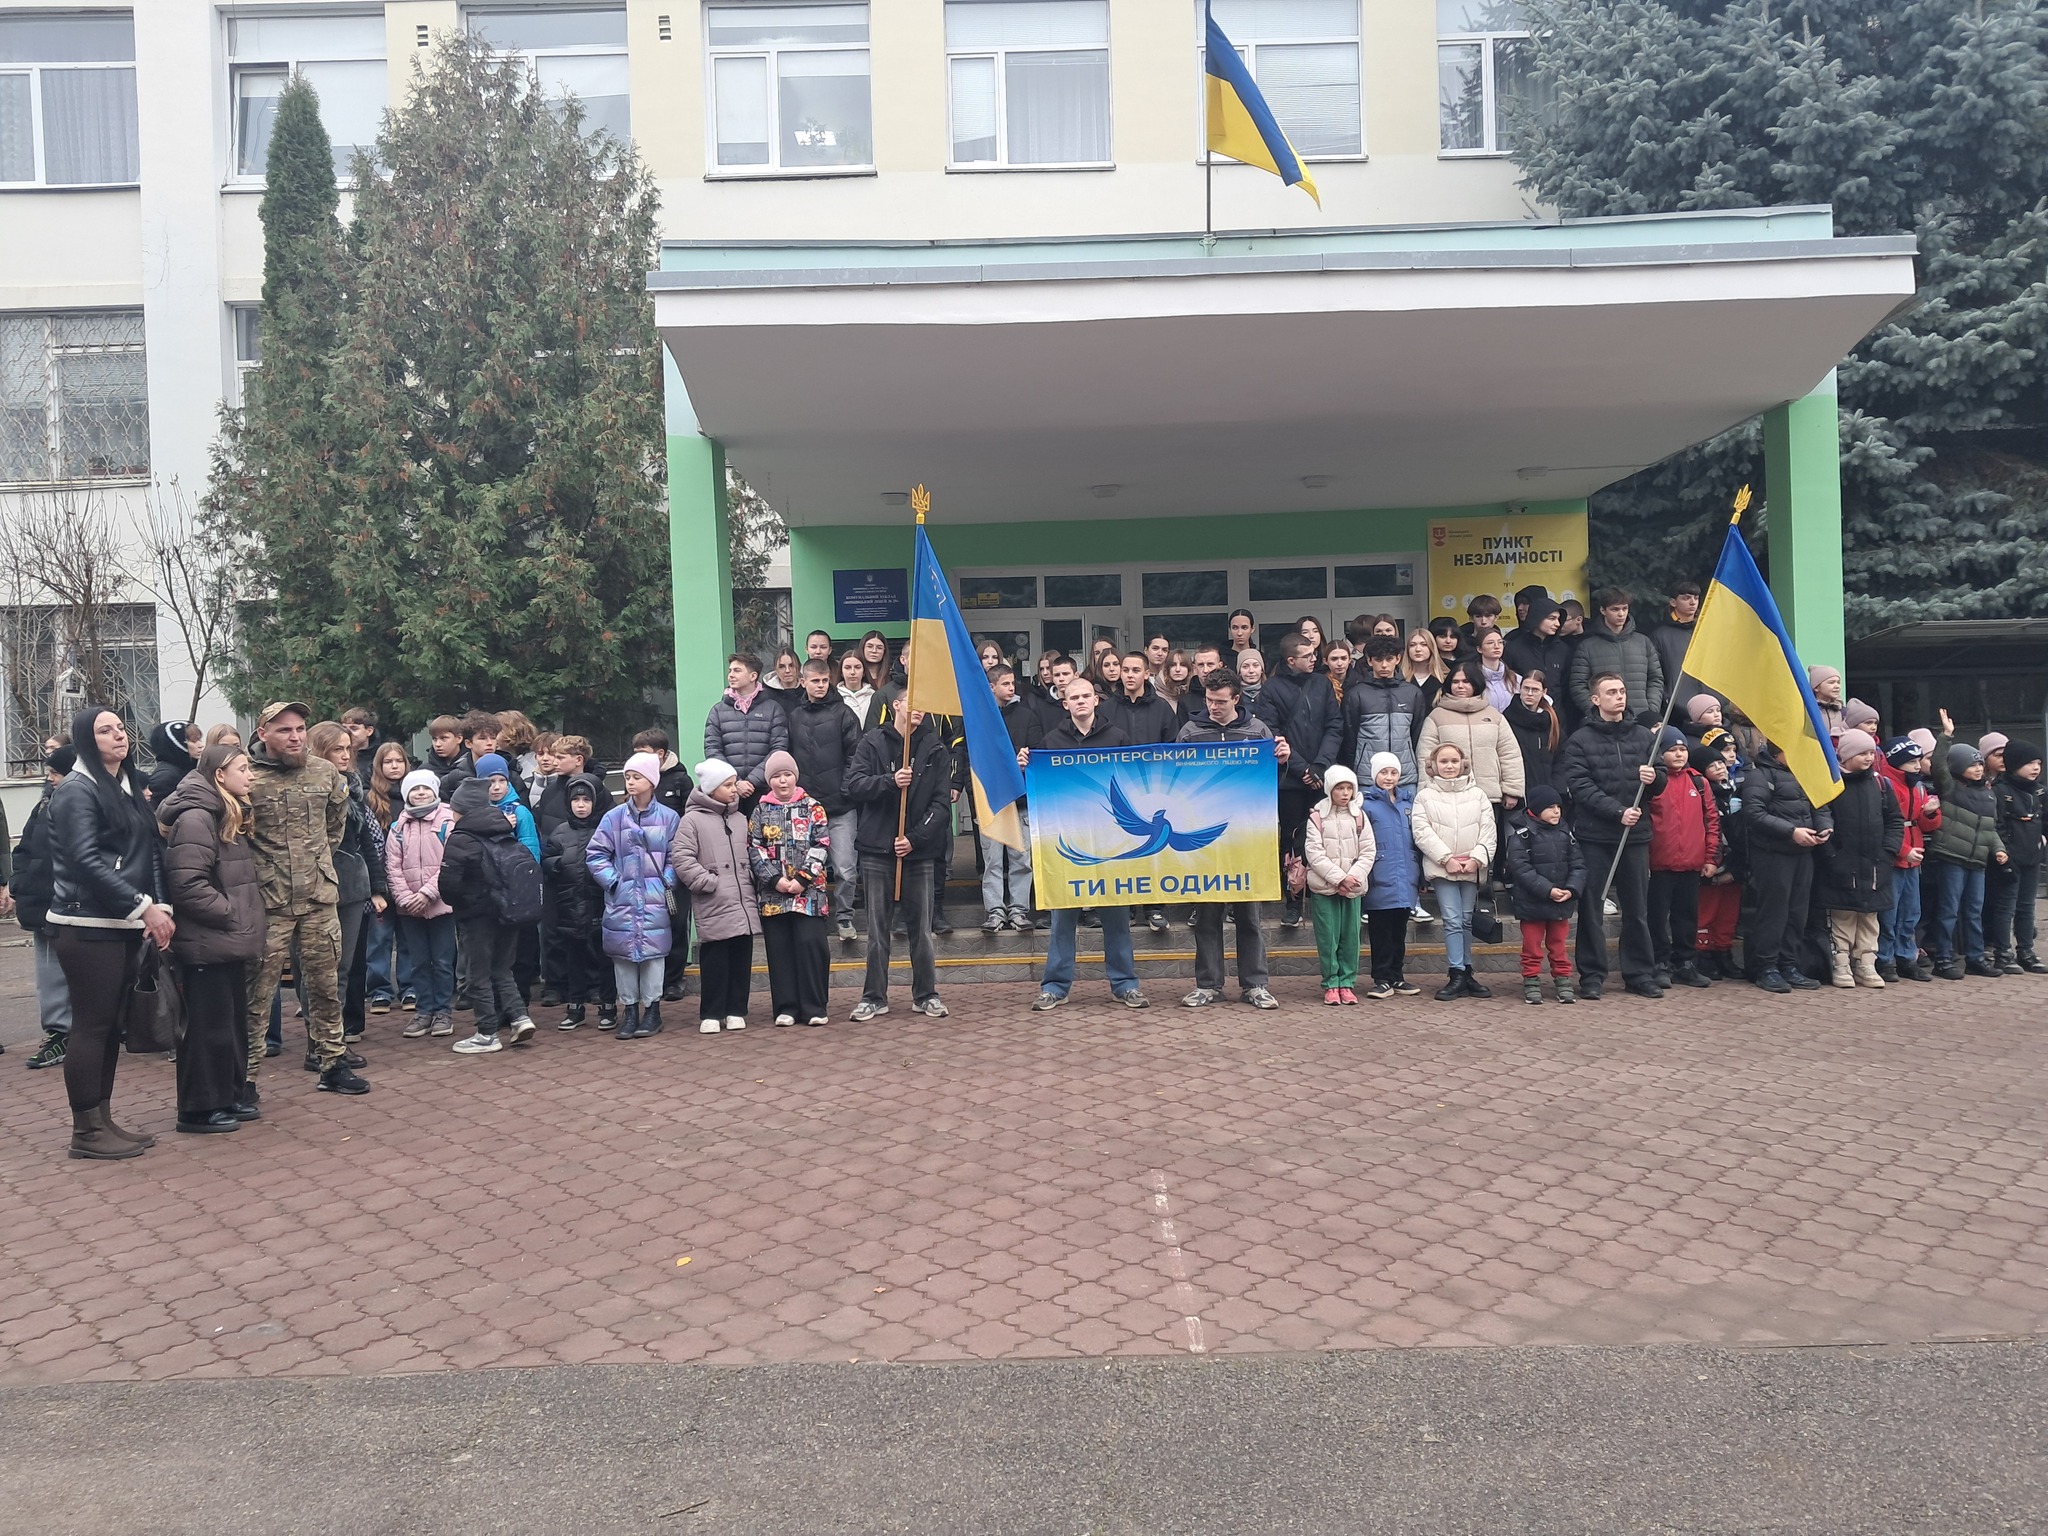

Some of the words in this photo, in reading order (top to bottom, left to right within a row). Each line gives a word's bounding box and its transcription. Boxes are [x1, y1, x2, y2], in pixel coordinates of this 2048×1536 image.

[1482, 535, 1534, 550] ПУНКТ
[1454, 550, 1563, 566] НЕЗЛАМНОСТІ
[1050, 748, 1197, 767] ВОЛОНТЕРСЬКИЙ
[1205, 747, 1260, 760] ЦЕНТР
[1068, 879, 1106, 897] ТИ
[1115, 876, 1151, 895] НЕ
[1160, 872, 1251, 896] ОДИН!
